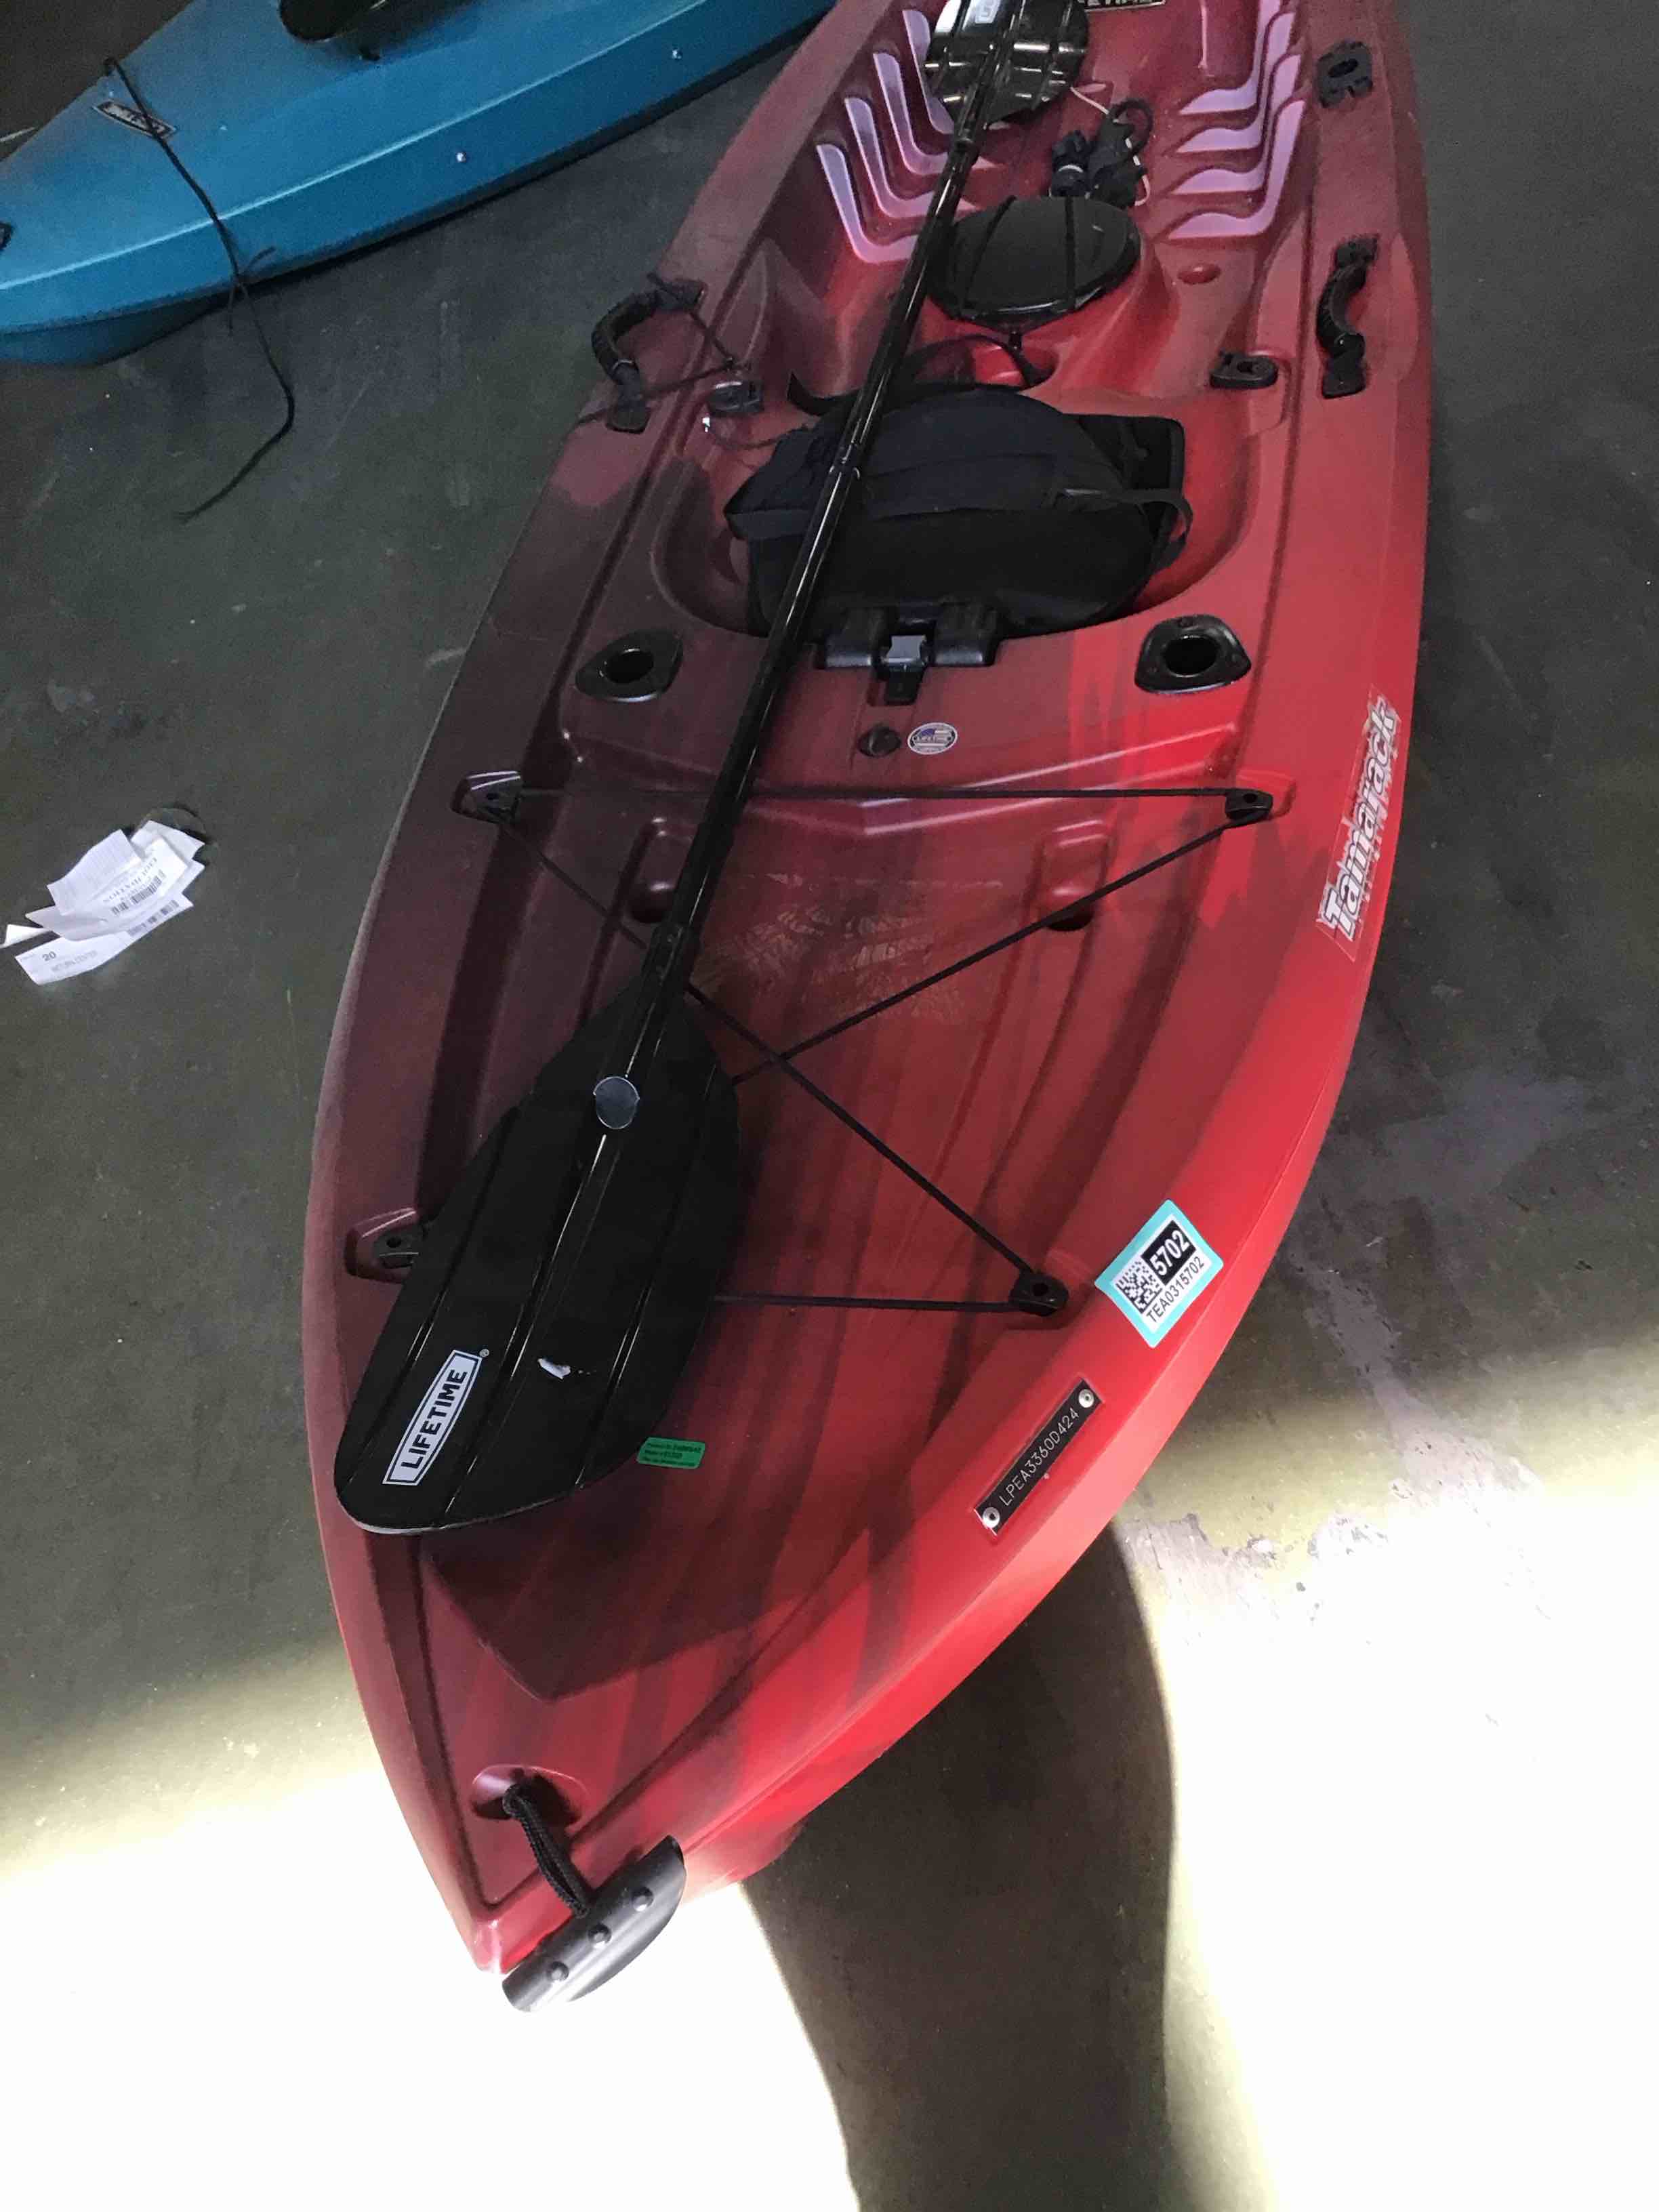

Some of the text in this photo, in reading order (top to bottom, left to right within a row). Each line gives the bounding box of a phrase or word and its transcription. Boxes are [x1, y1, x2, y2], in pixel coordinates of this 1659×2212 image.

[1324, 705, 1396, 939] Tamarack
[42, 951, 57, 962] 20
[1149, 1229, 1191, 1276] 5702
[1146, 1256, 1205, 1323] TEA0315702
[401, 1369, 468, 1469] LIFETIME
